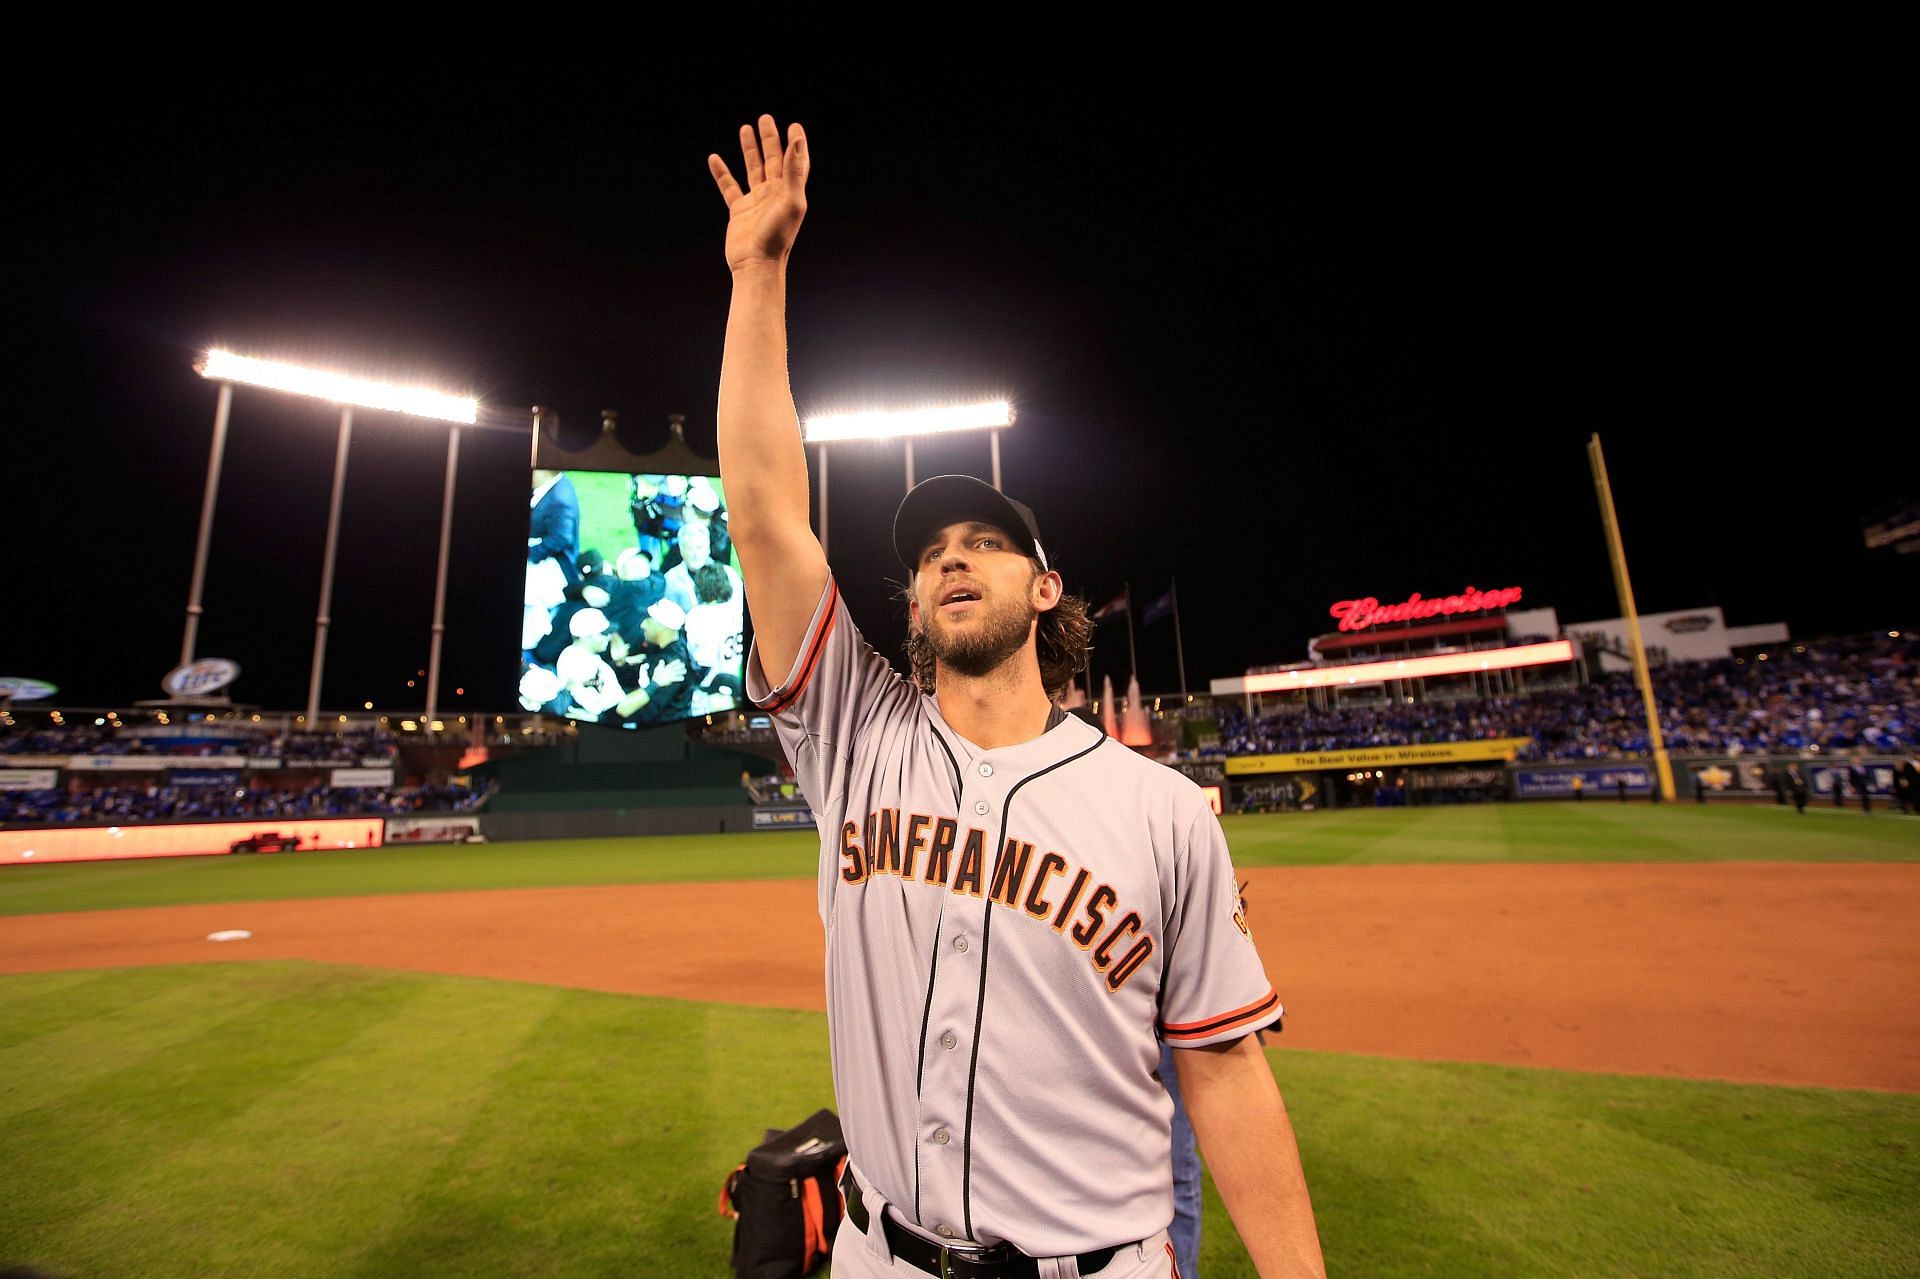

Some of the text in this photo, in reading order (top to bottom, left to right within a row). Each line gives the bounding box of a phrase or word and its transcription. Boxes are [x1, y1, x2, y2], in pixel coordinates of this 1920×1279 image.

[1330, 586, 1523, 632] Budweiser
[1296, 757, 1315, 768] The
[1319, 754, 1345, 766] Best
[1349, 753, 1381, 765] Value
[1384, 751, 1396, 762] in
[1243, 782, 1296, 803] Sprint
